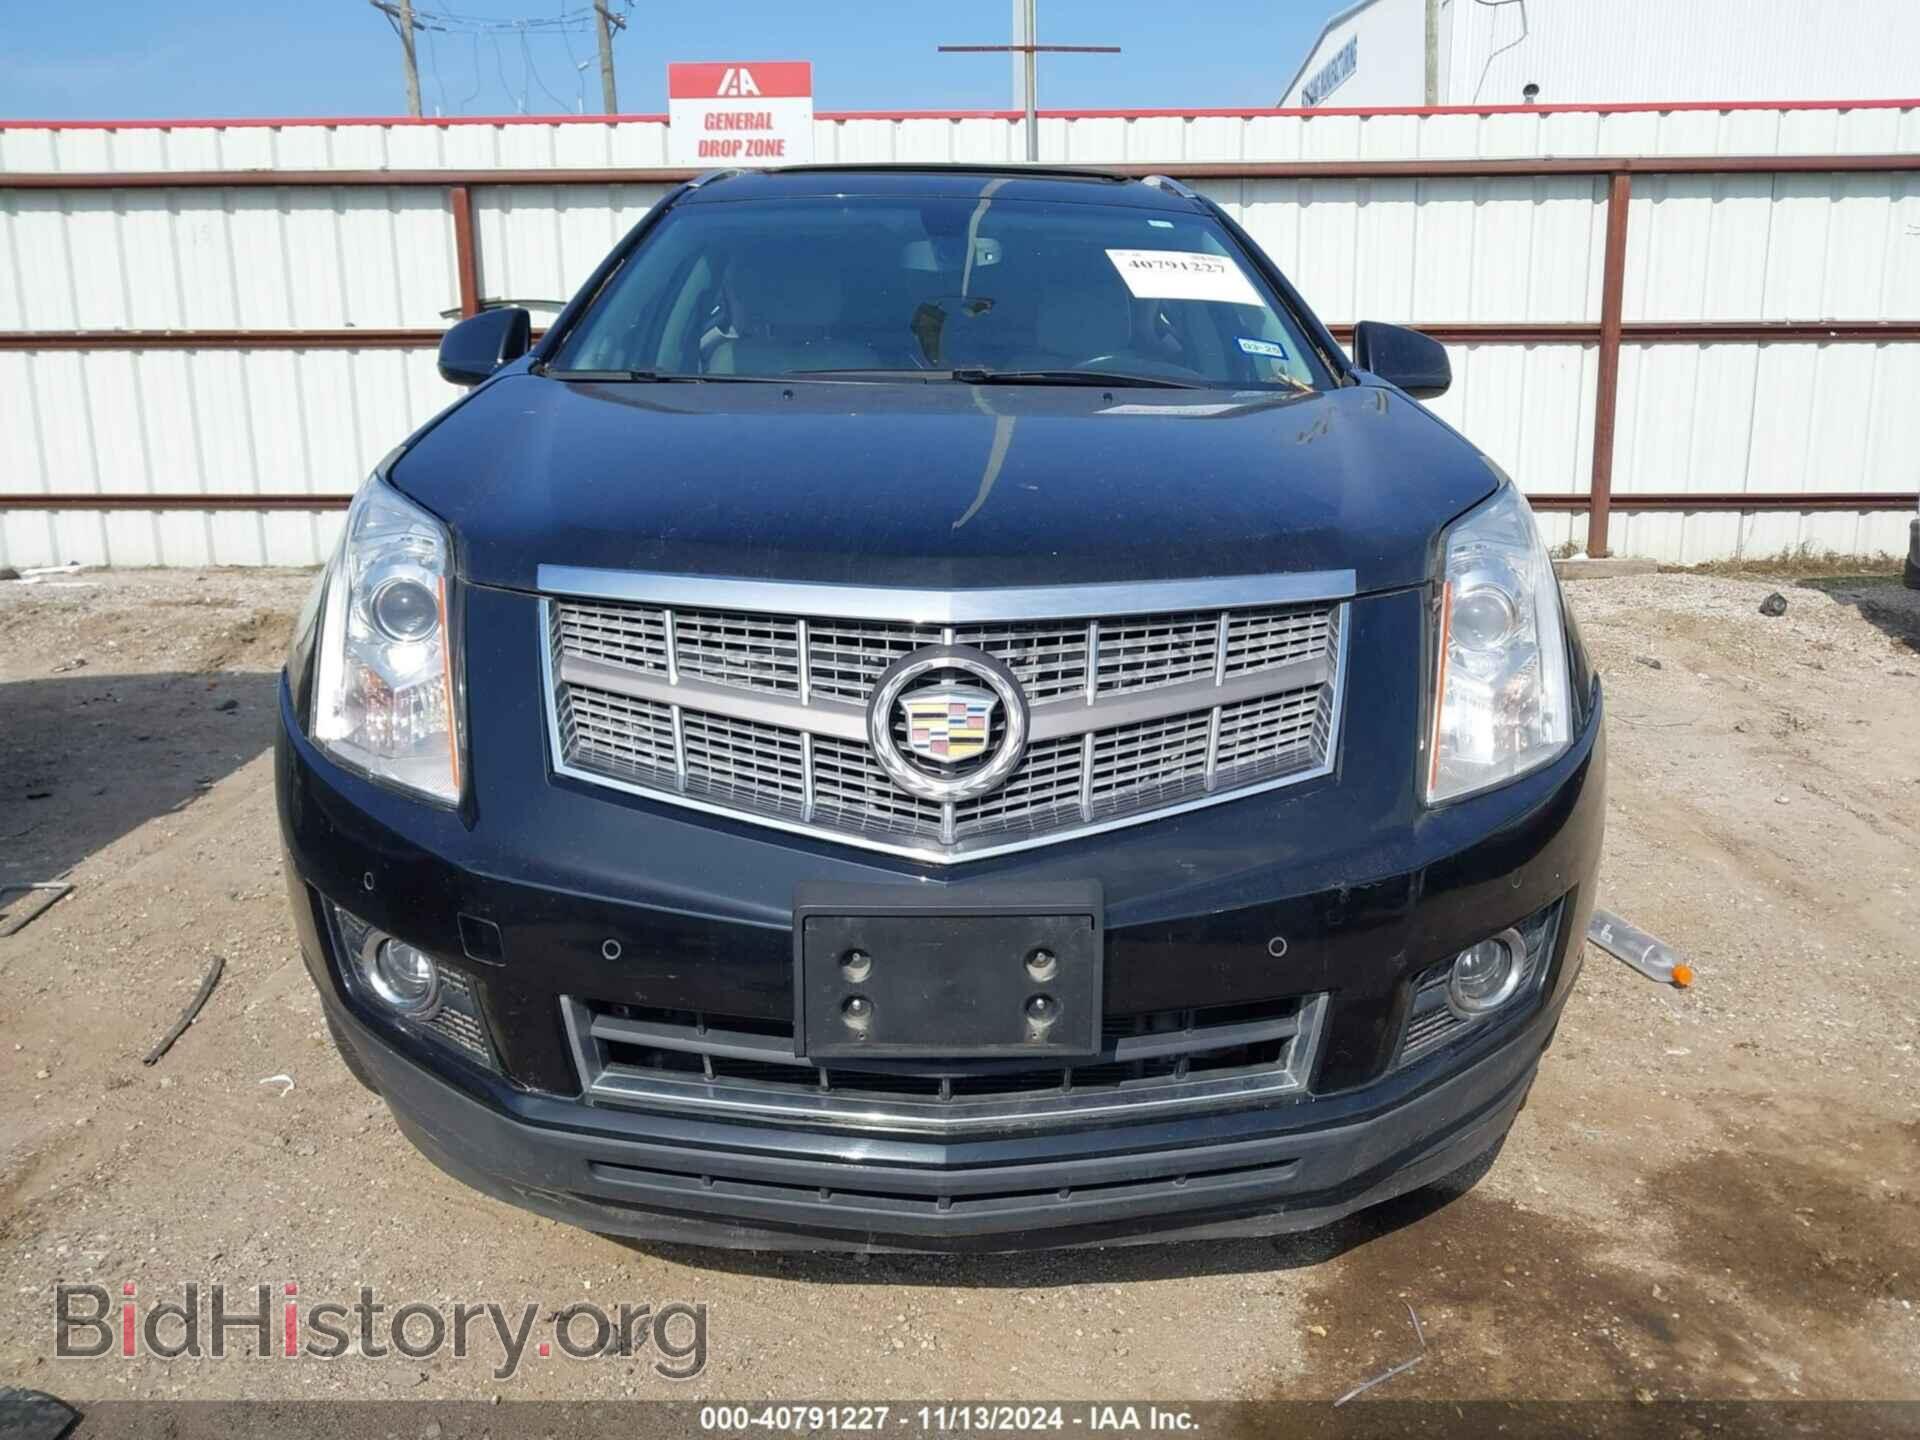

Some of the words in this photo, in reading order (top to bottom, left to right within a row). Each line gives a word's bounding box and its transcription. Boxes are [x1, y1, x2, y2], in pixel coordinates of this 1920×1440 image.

[704, 111, 774, 131] GENERAL
[698, 139, 743, 157] DROP
[745, 138, 786, 157] ZONE
[1128, 258, 1226, 274] 40791227
